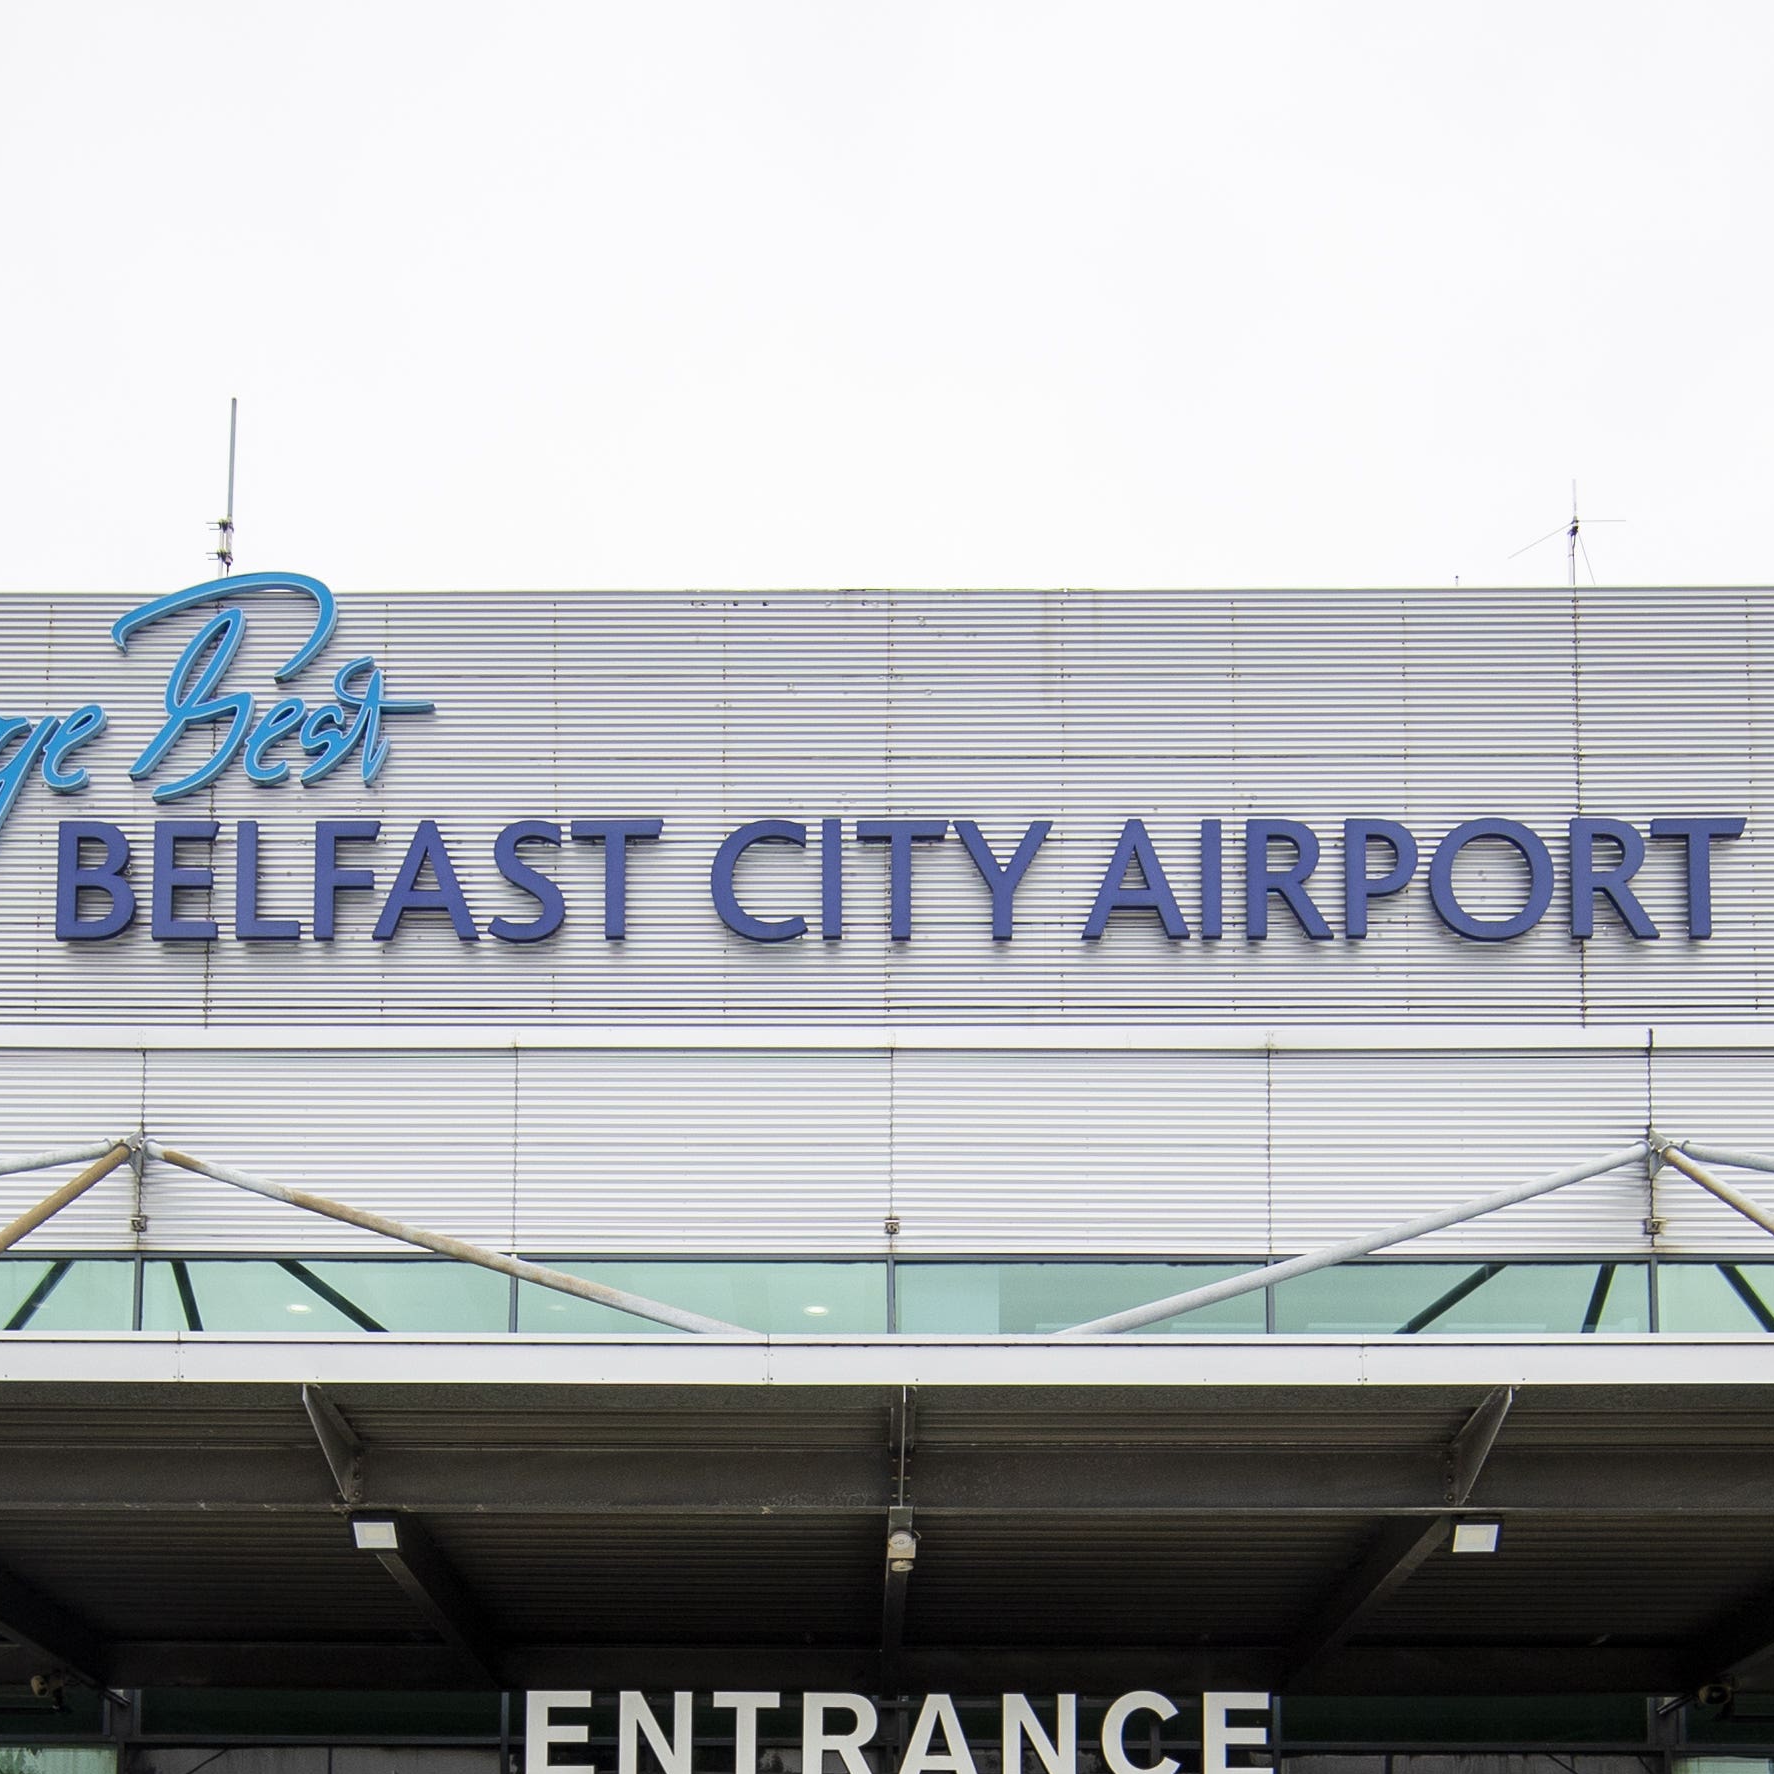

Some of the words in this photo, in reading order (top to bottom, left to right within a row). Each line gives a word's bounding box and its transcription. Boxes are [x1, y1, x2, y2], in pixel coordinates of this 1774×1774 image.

[111, 572, 435, 805] Best
[55, 819, 664, 944] BELFAST
[710, 818, 1053, 943] CITY
[1081, 816, 1748, 944] AIRPORT
